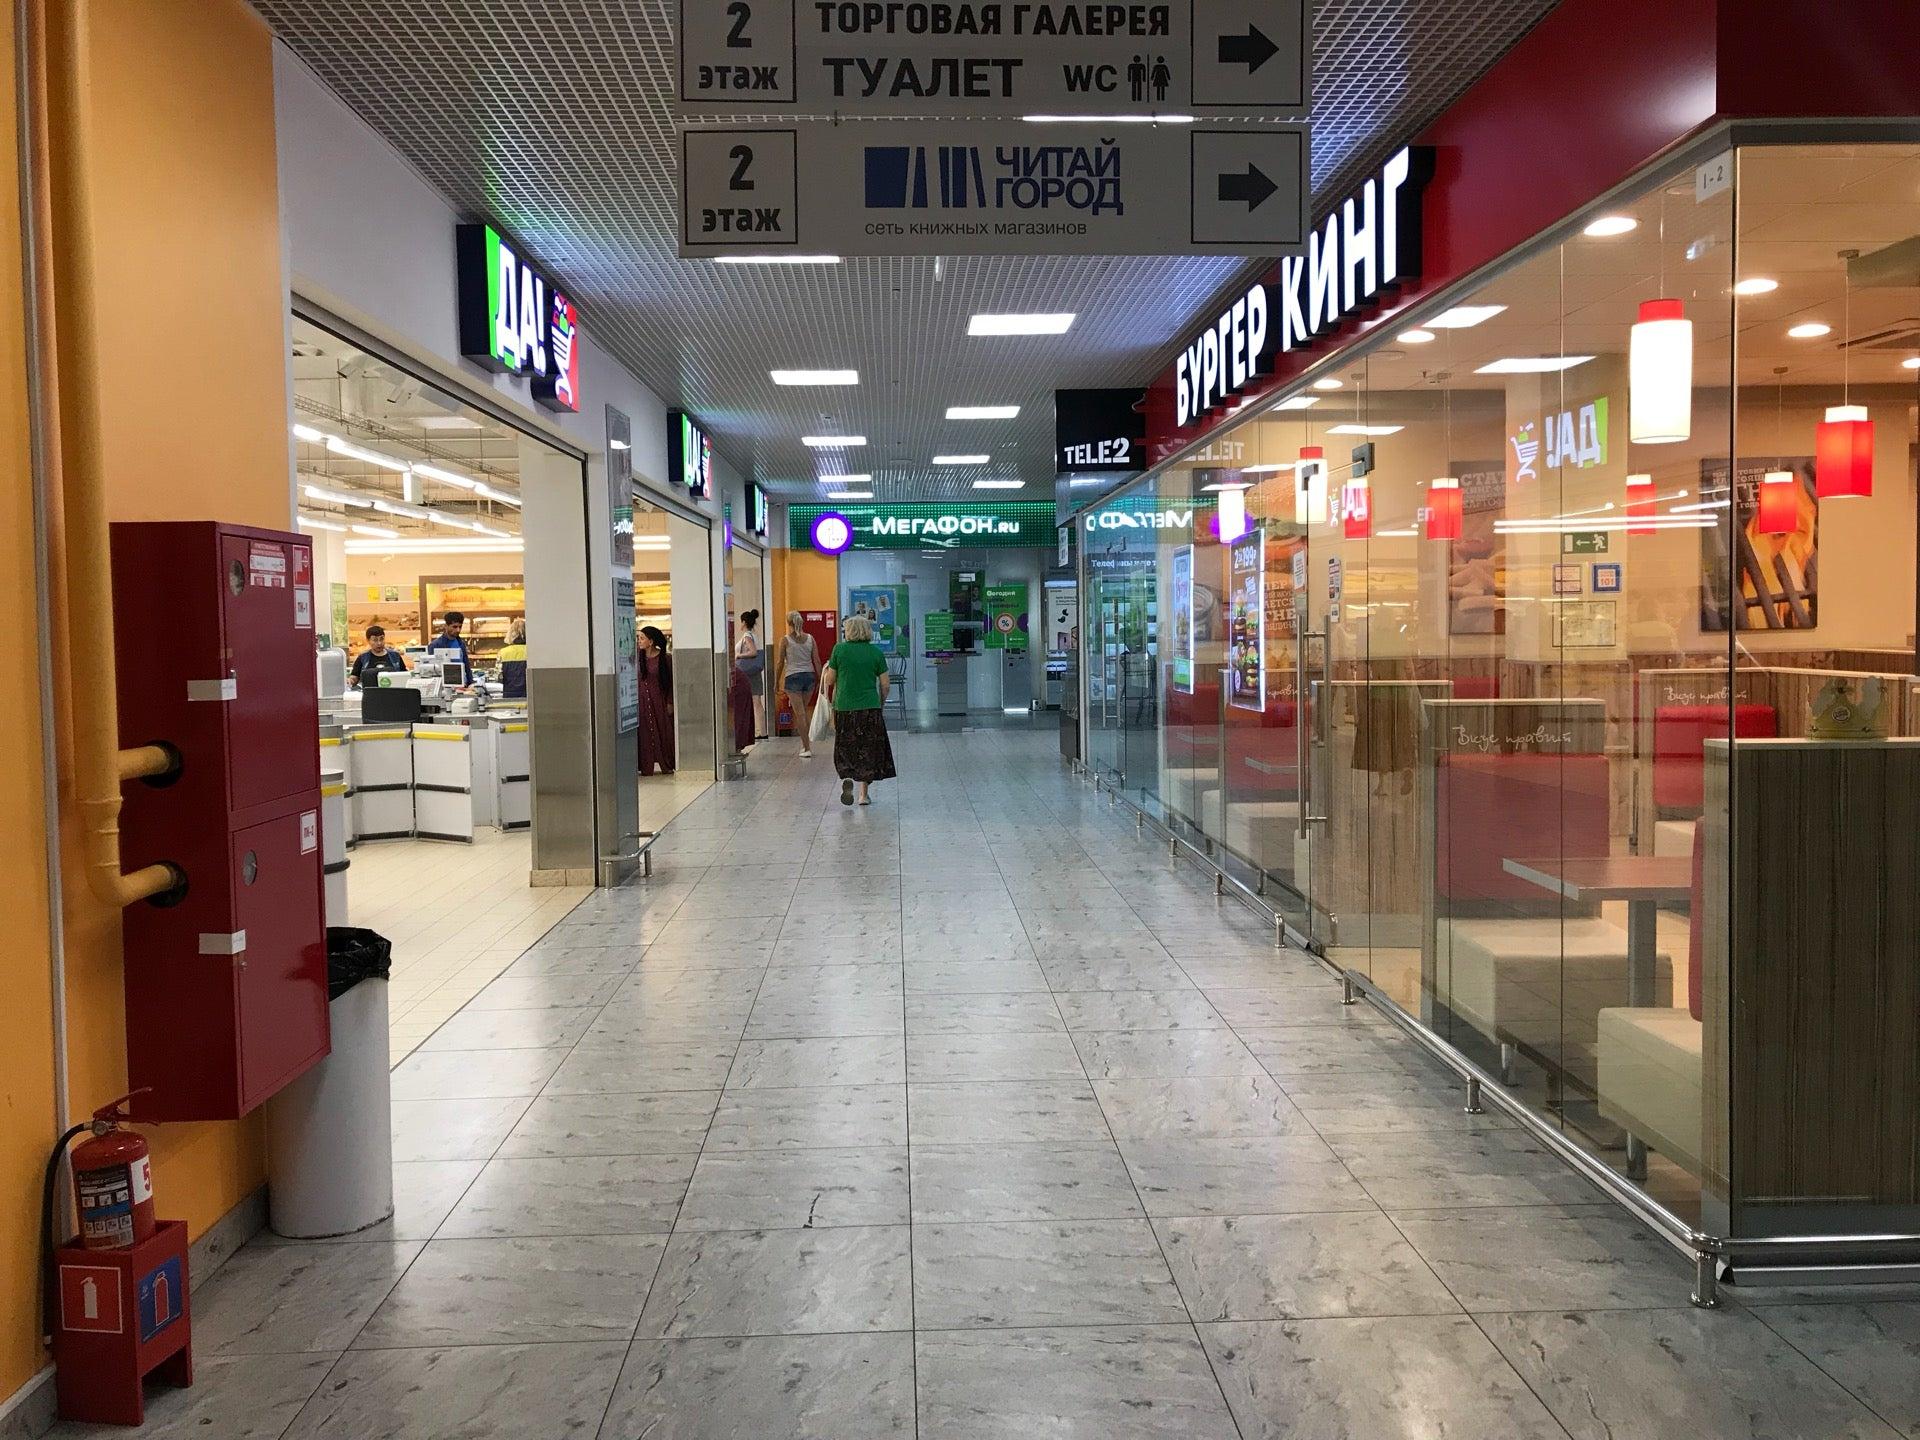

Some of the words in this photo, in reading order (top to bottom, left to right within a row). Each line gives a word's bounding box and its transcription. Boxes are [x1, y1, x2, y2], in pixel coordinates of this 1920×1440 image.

[726, 1, 752, 48] 2
[815, 2, 1001, 35] ТОРГОВАЯ
[1013, 4, 1169, 36] ГАЛЕРЕЯ
[698, 65, 779, 90] этаж
[822, 57, 1023, 98] ТУАЛЕТ
[1063, 64, 1117, 92] WC
[729, 145, 754, 190] 2
[996, 138, 1120, 177] ЧИТАЙ
[996, 177, 1123, 215] ГОРОД
[702, 208, 781, 232] этаж
[865, 222, 903, 235] сеть
[909, 222, 988, 235] книжных
[994, 222, 1087, 235] магазинов
[1177, 284, 1267, 427] БУРГЕР
[1282, 146, 1408, 352] КИНГ
[496, 243, 546, 374] ДА!
[1064, 437, 1130, 464] TELE2
